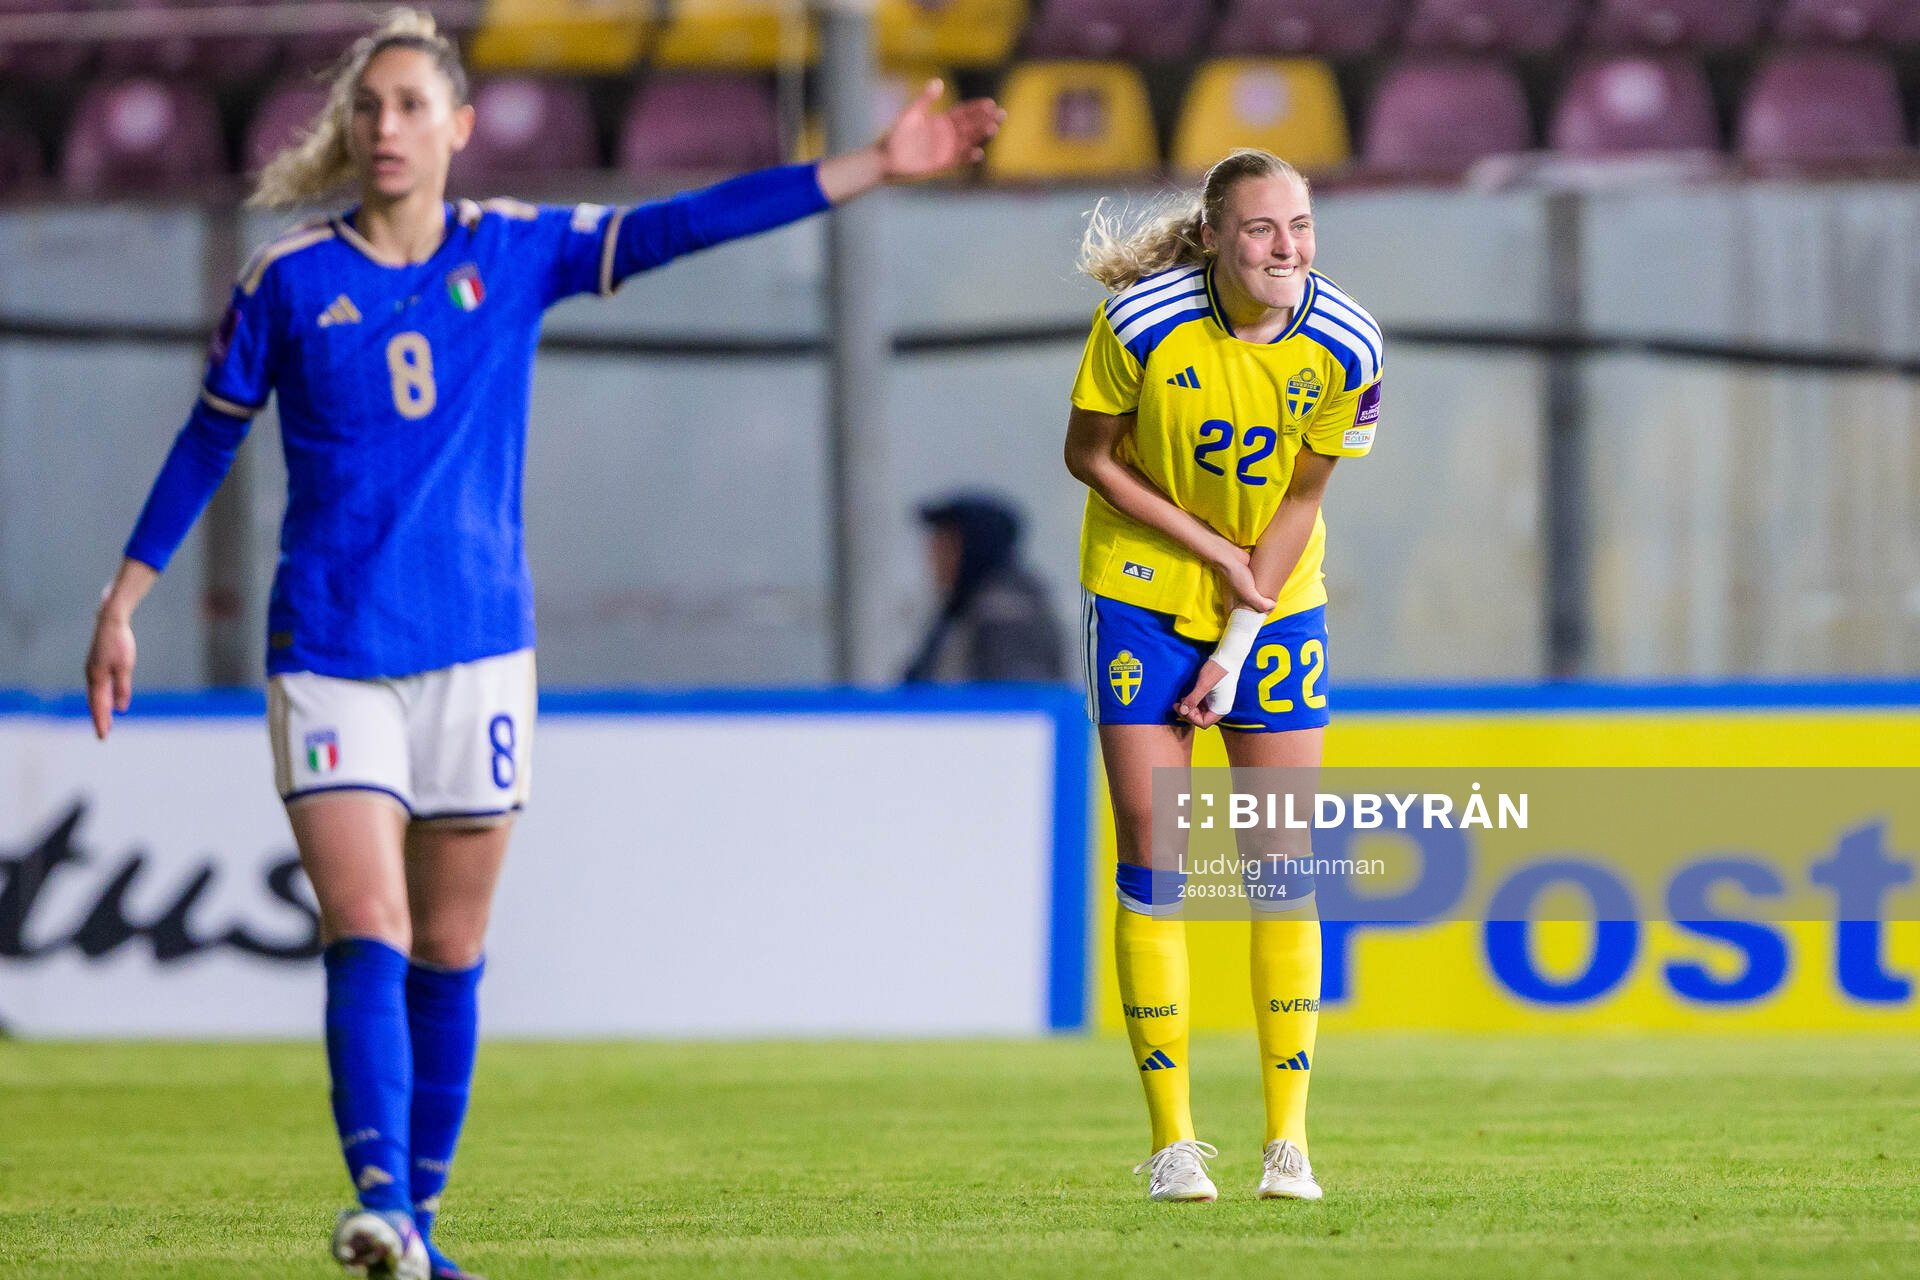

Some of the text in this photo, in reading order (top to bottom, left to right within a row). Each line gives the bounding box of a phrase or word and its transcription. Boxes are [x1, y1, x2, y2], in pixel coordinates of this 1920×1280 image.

[387, 331, 437, 420] 8
[1194, 419, 1277, 485] 22
[1256, 638, 1327, 713] 22
[489, 713, 516, 789] 8
[1311, 795, 1915, 1004] Post
[1123, 1003, 1179, 1019] SVERIGE
